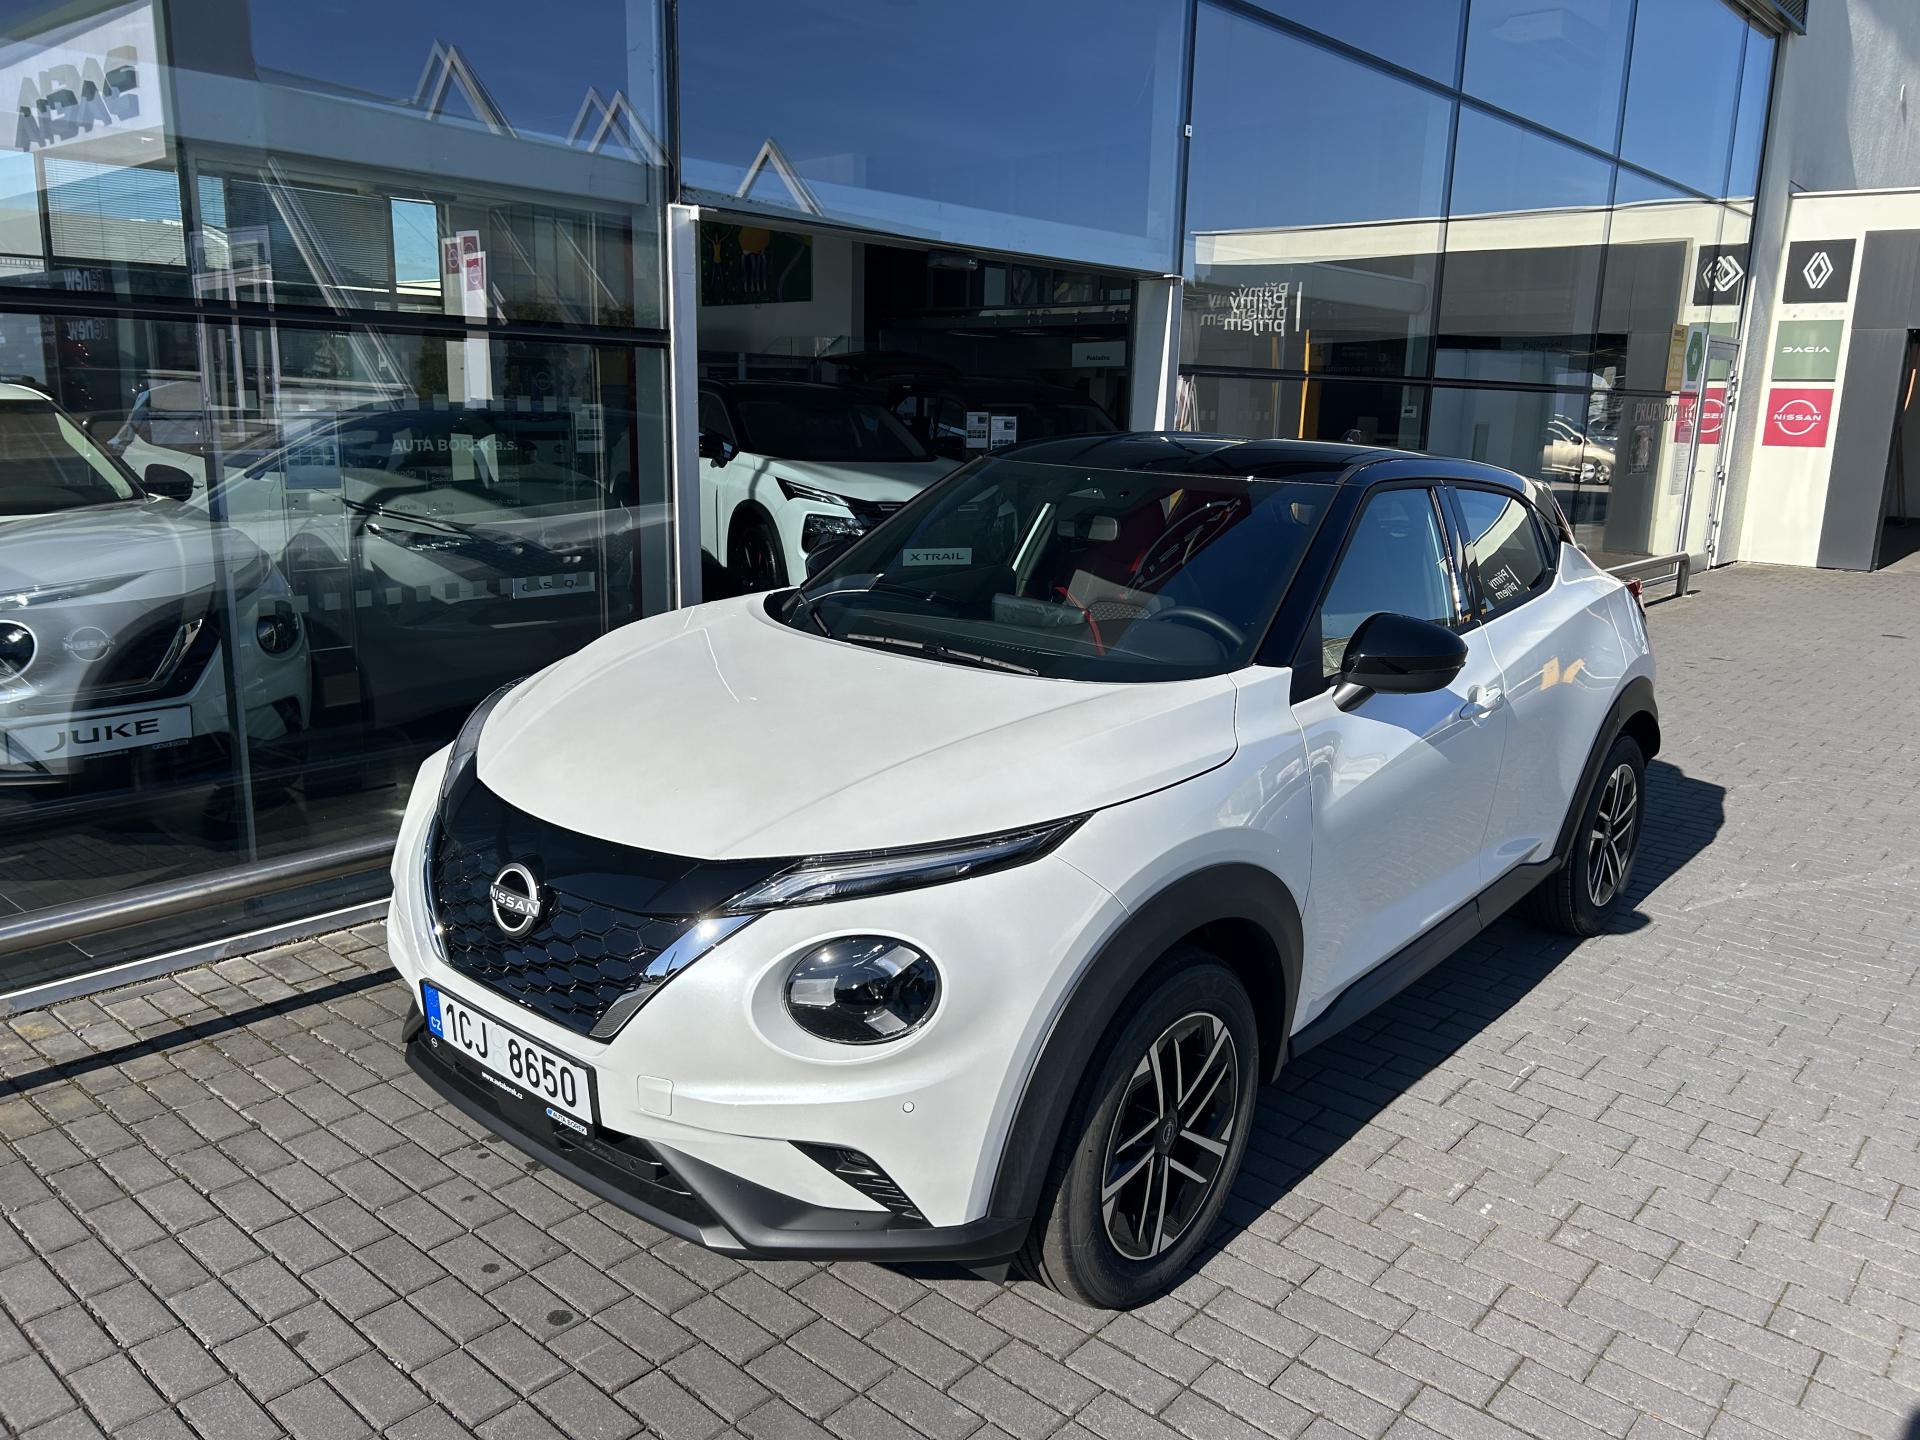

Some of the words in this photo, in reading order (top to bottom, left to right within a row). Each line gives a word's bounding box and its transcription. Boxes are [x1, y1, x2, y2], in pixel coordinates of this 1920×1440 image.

[1773, 413, 1822, 421] NISSAN
[391, 439, 434, 452] AUTA
[45, 717, 160, 753] JUKE
[490, 884, 539, 915] NISSAN
[430, 1015, 442, 1032] CZ
[445, 1003, 489, 1059] 1CJ
[507, 1038, 577, 1108] 8650
